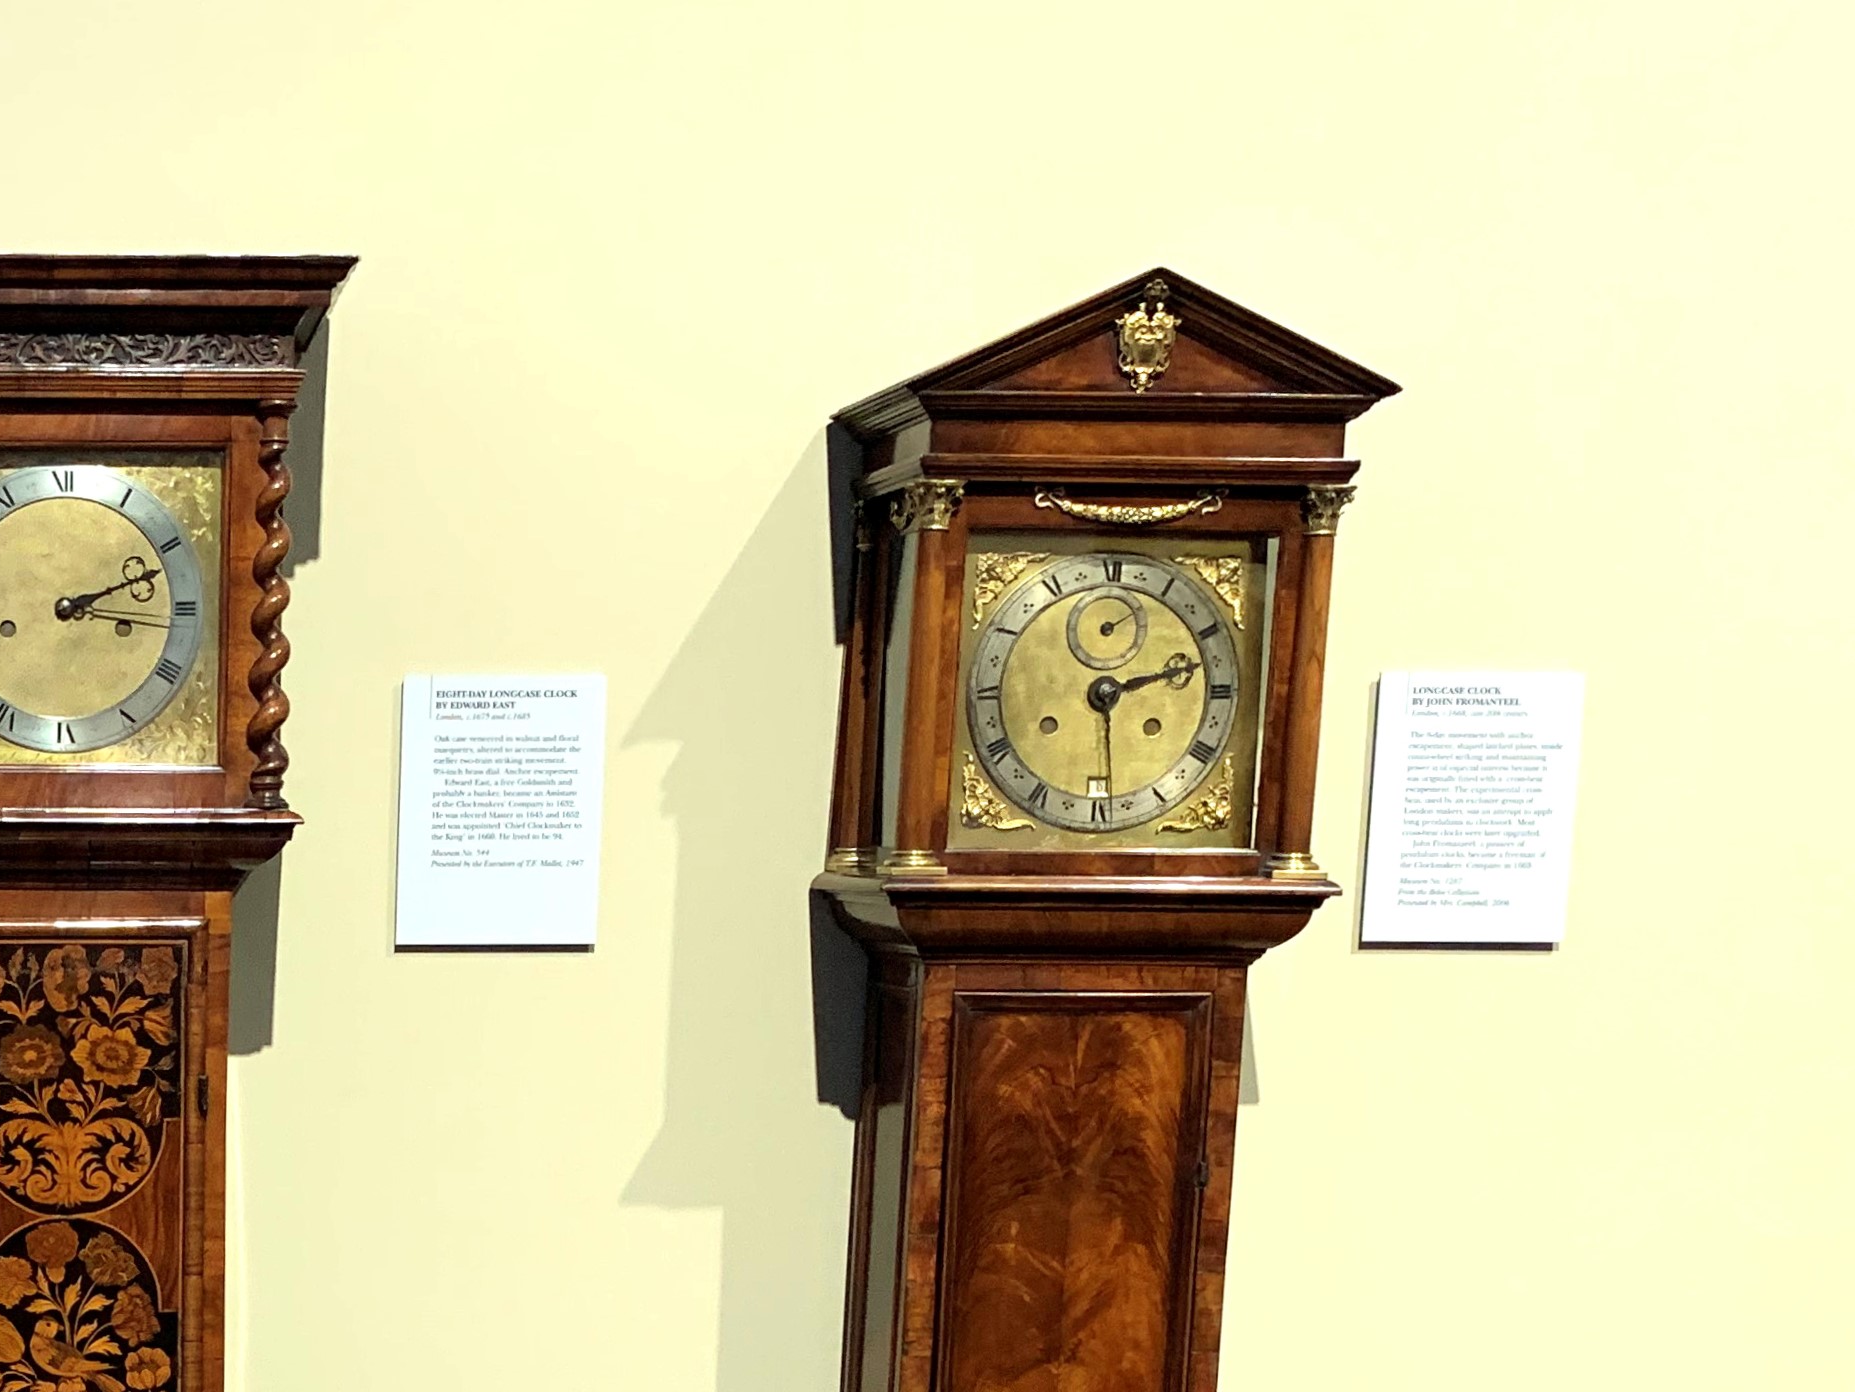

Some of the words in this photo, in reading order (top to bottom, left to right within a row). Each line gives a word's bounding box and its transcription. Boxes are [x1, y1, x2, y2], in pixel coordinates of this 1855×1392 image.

[436, 690, 487, 698] EIGHT-DAY
[489, 690, 542, 698] LONGCASE
[543, 690, 578, 698] CLOCK
[1413, 687, 1465, 695] LONGCASE
[1467, 687, 1501, 695] CLOCK
[436, 701, 448, 709] BY
[450, 701, 490, 709] EDWARD
[492, 701, 516, 709] EAST
[1412, 698, 1424, 706] BY
[1425, 698, 1453, 707] JOHN
[1455, 698, 1521, 706] FROMANTEEL
[508, 800, 544, 809] Company
